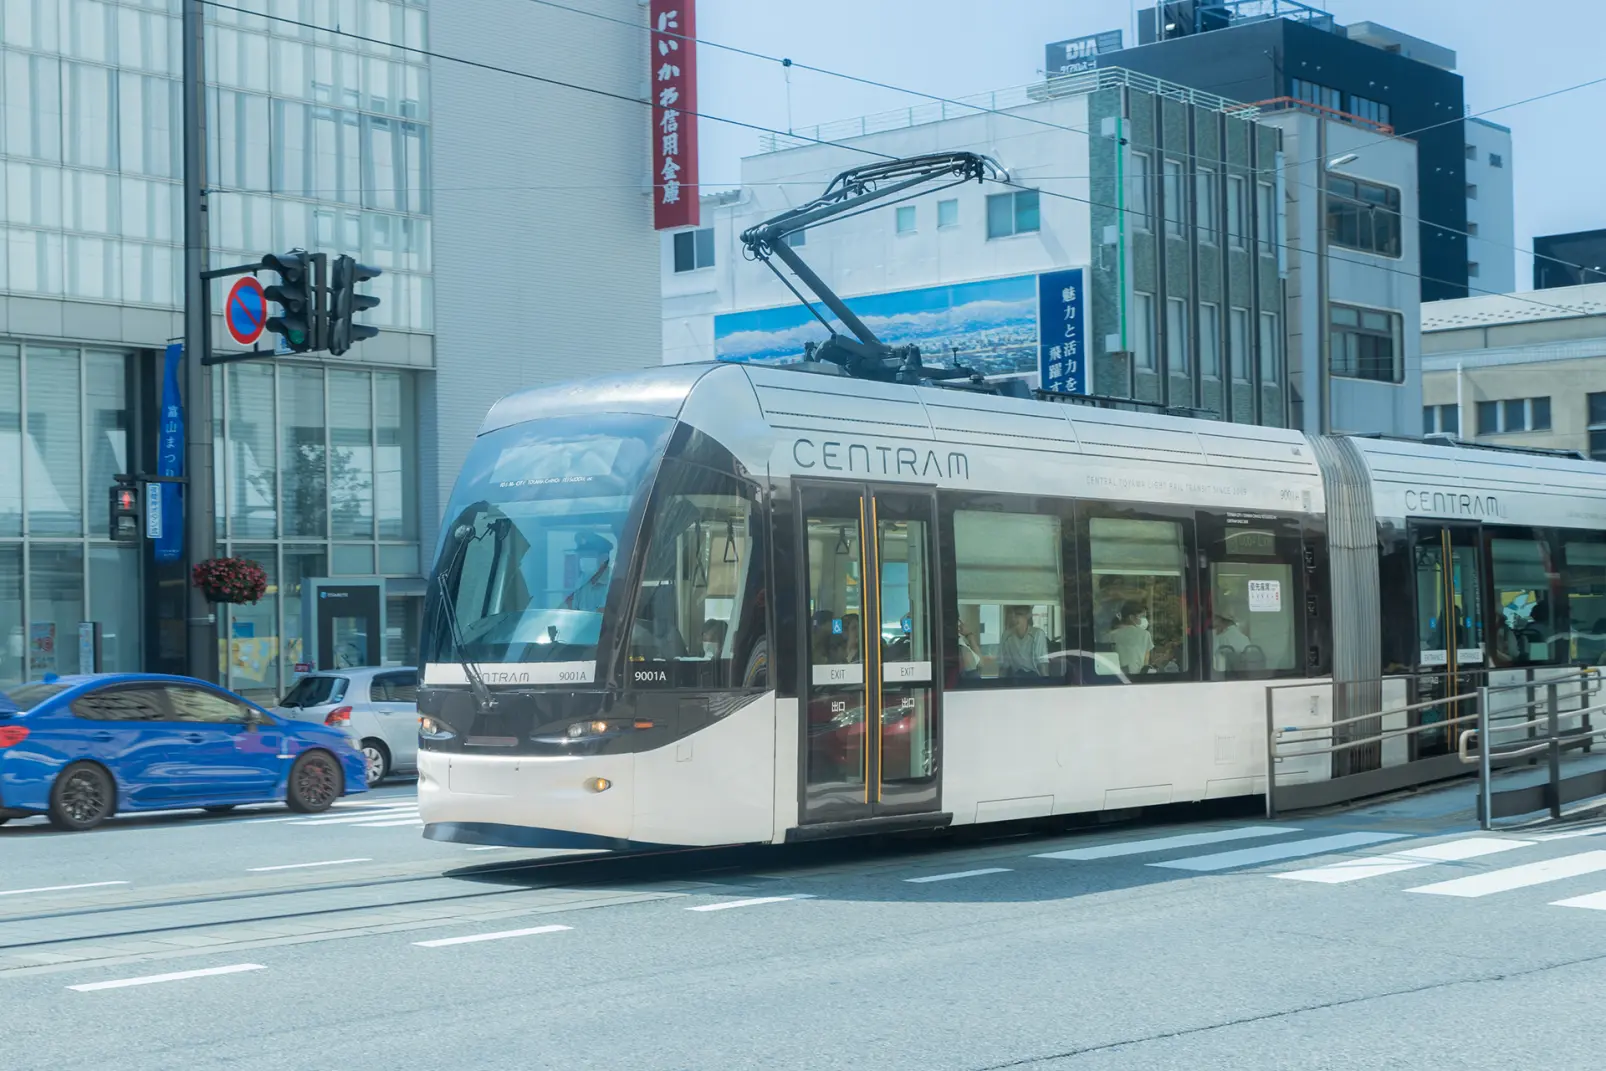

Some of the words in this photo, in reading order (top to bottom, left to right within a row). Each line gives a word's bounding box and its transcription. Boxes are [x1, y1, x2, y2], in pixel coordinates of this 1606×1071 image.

[1065, 37, 1099, 61] DIA
[657, 10, 681, 205] にいかわ信用金庫
[1062, 286, 1078, 392] 魅力と活力を
[793, 438, 969, 480] CENTRAM
[1405, 489, 1499, 517] CENTRAM
[465, 672, 530, 683] NTRAM
[559, 671, 587, 681] 9001A
[634, 670, 667, 681] 9001A
[830, 669, 846, 680] EXIT
[900, 667, 915, 677] EXIT
[831, 701, 846, 712] 出口
